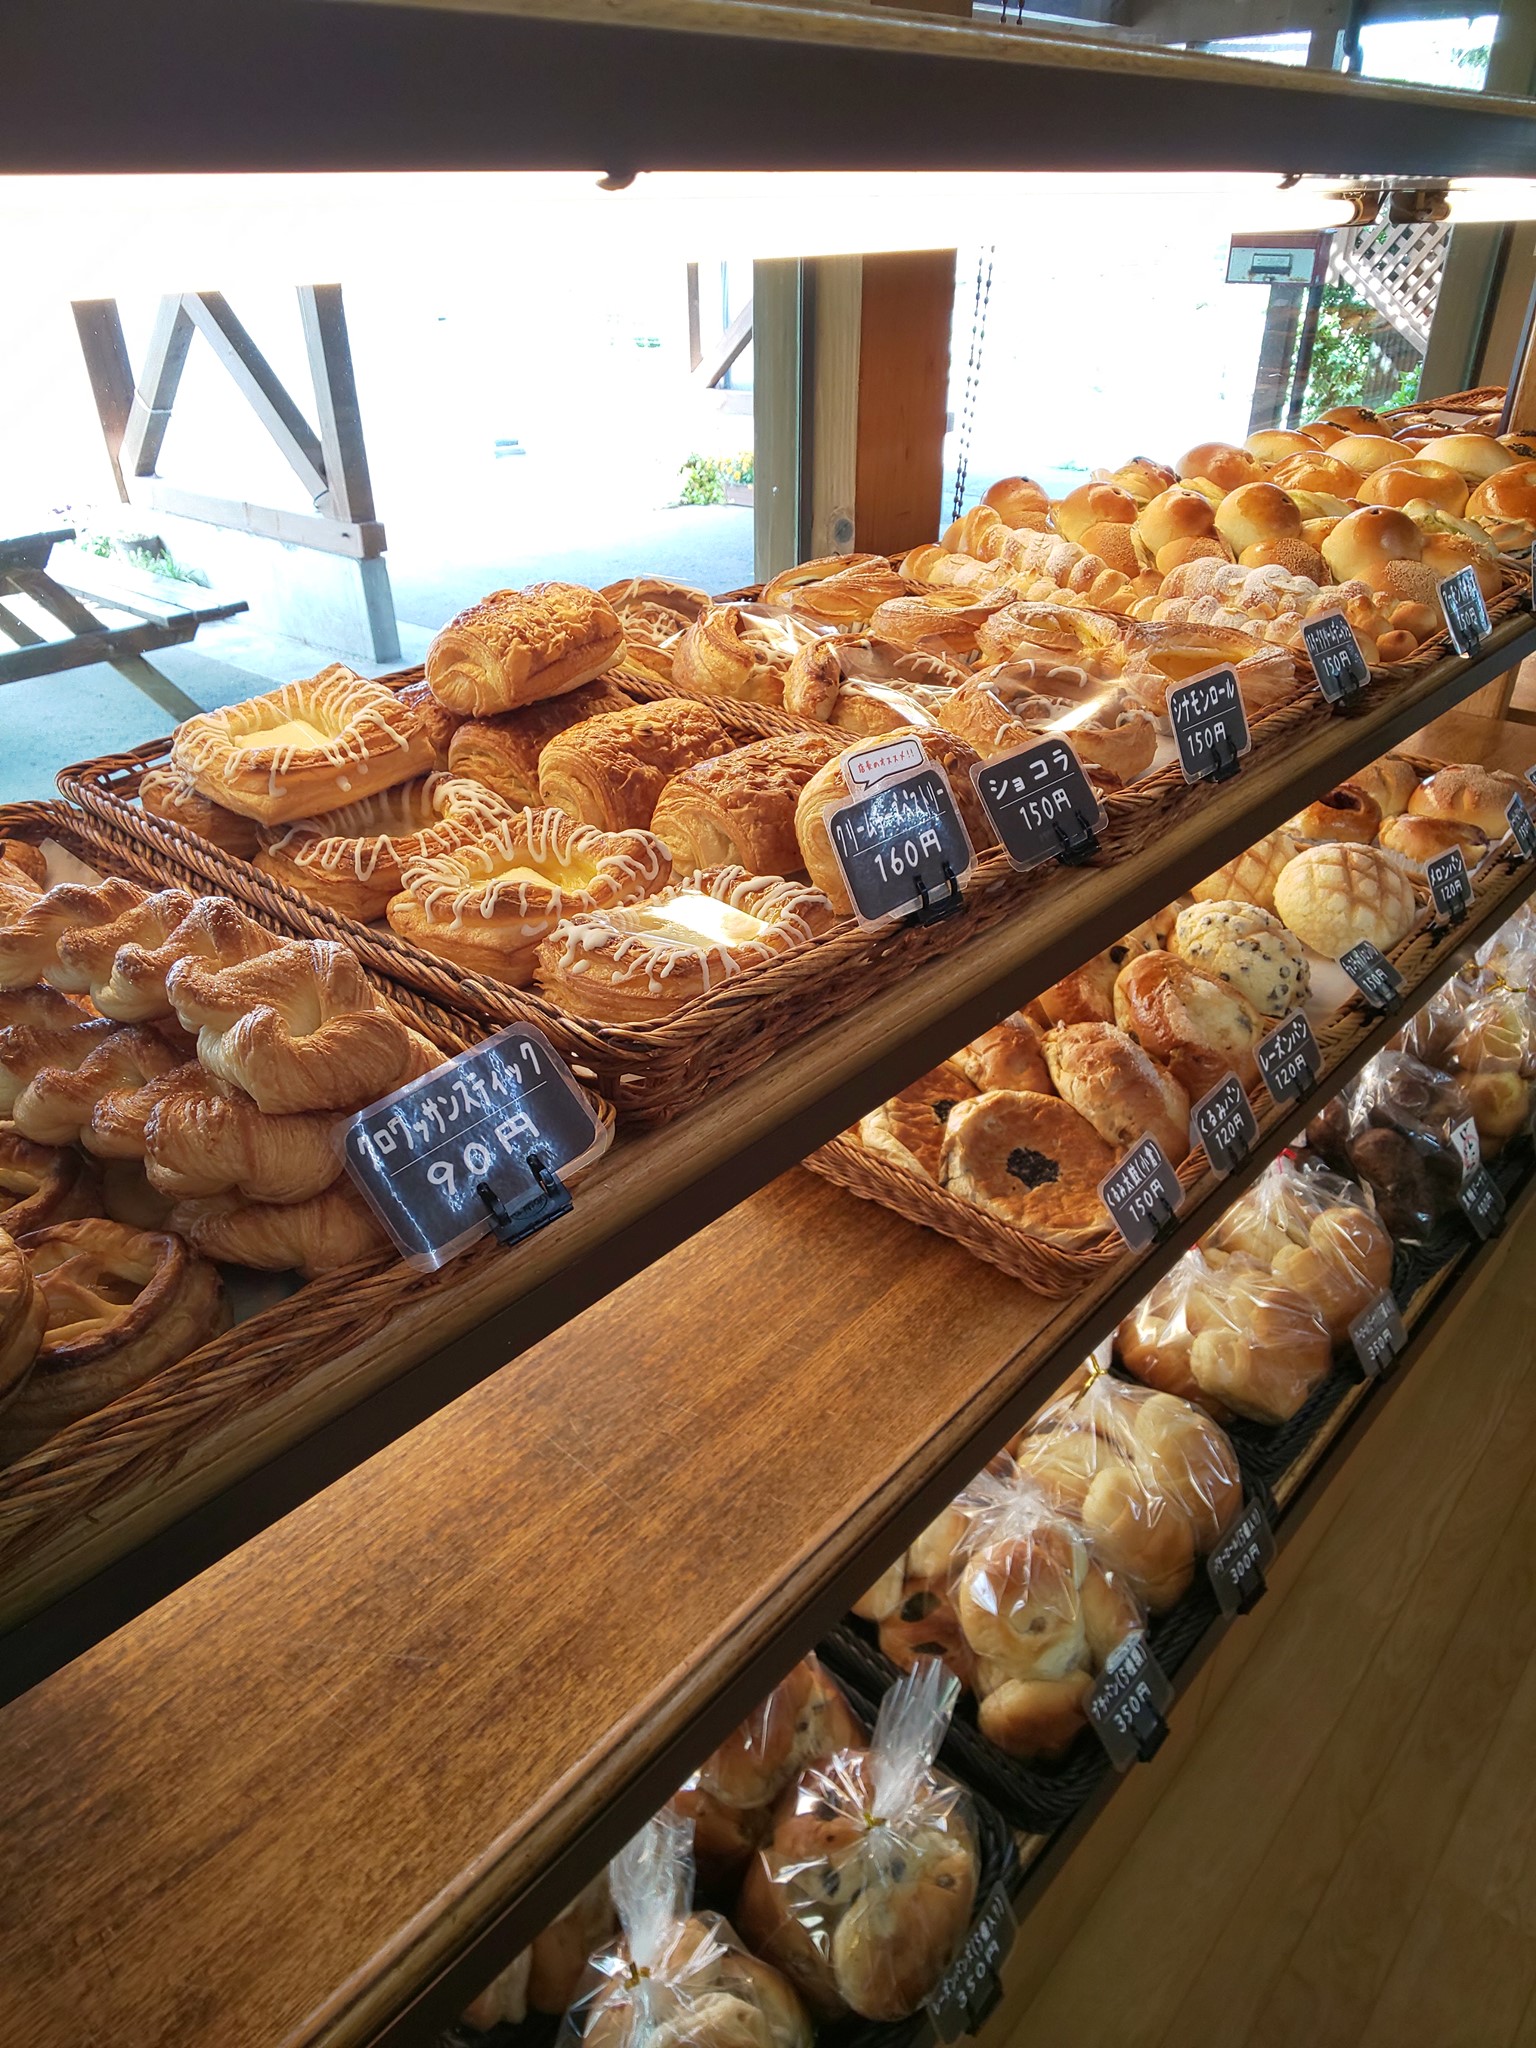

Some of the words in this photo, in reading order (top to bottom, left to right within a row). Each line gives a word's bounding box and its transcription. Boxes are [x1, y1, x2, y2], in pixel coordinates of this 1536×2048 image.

[1322, 650, 1351, 677] 150円
[1172, 678, 1235, 724] シナモンロール
[1187, 721, 1227, 757] 150円
[989, 748, 1069, 800] ショコラ
[1020, 788, 1072, 831] 150円
[874, 828, 942, 883] 160円
[1431, 855, 1462, 887] メロンパン
[1440, 879, 1463, 902] 120円
[1362, 968, 1388, 992] 150円
[1259, 1021, 1307, 1072] レーズンパン
[1275, 1054, 1307, 1090] 120円
[356, 1041, 542, 1172] クロワッサンスティック
[1201, 1086, 1240, 1133] くるみパン
[1215, 1112, 1245, 1150] 120円
[426, 1111, 540, 1196] 90円
[1129, 1178, 1165, 1222] 150円
[1230, 1542, 1261, 1585] 300円
[1113, 1680, 1152, 1733] 350円
